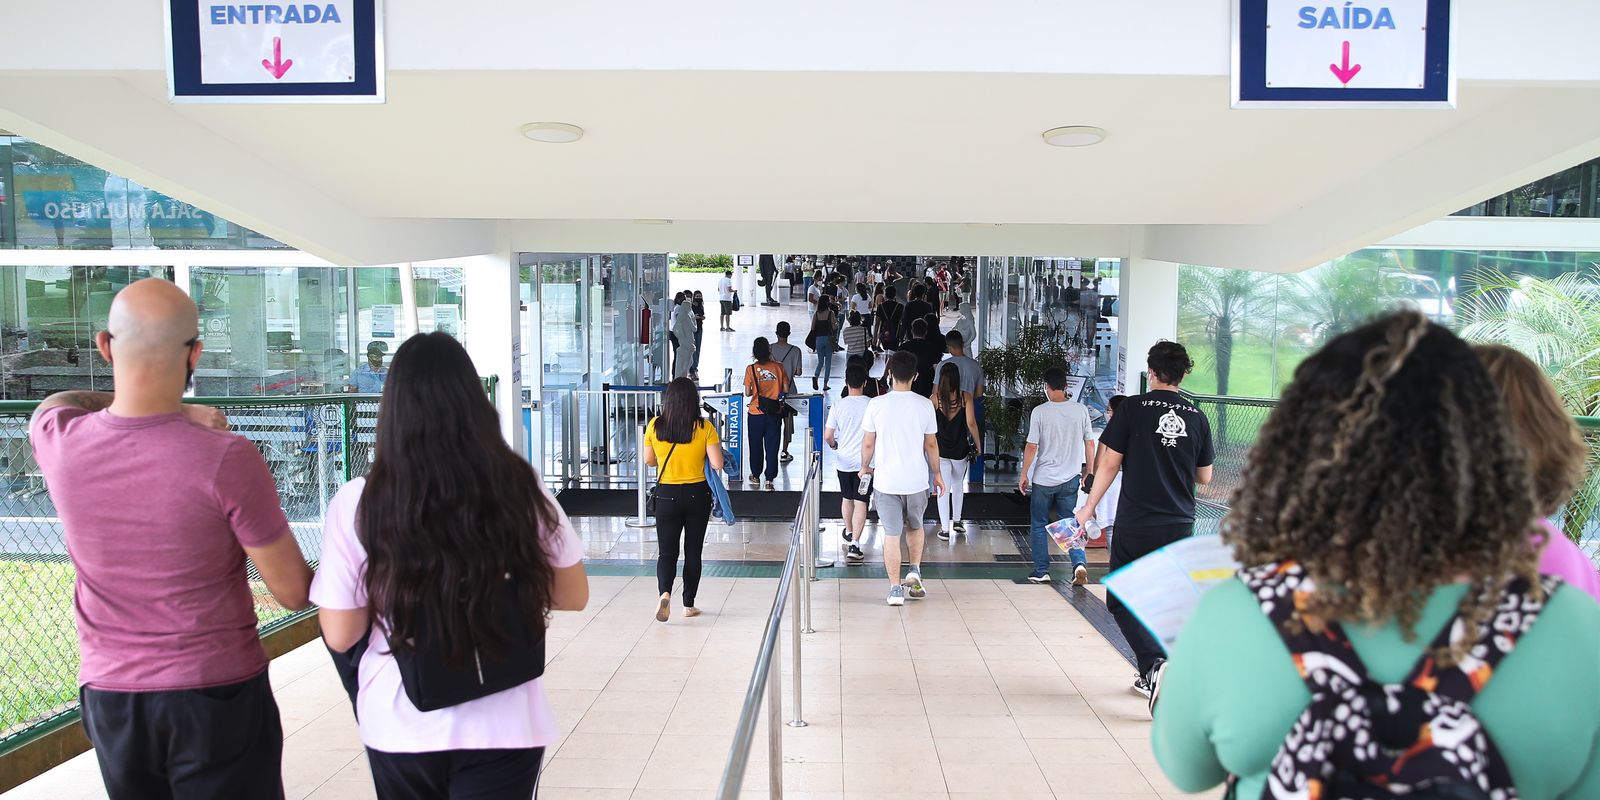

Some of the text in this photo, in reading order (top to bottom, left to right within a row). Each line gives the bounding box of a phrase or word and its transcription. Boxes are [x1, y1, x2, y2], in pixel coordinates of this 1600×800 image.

[210, 4, 341, 25] ENTRADA
[1297, 2, 1396, 30] SAÍDA
[729, 401, 739, 448] ENTRADA
